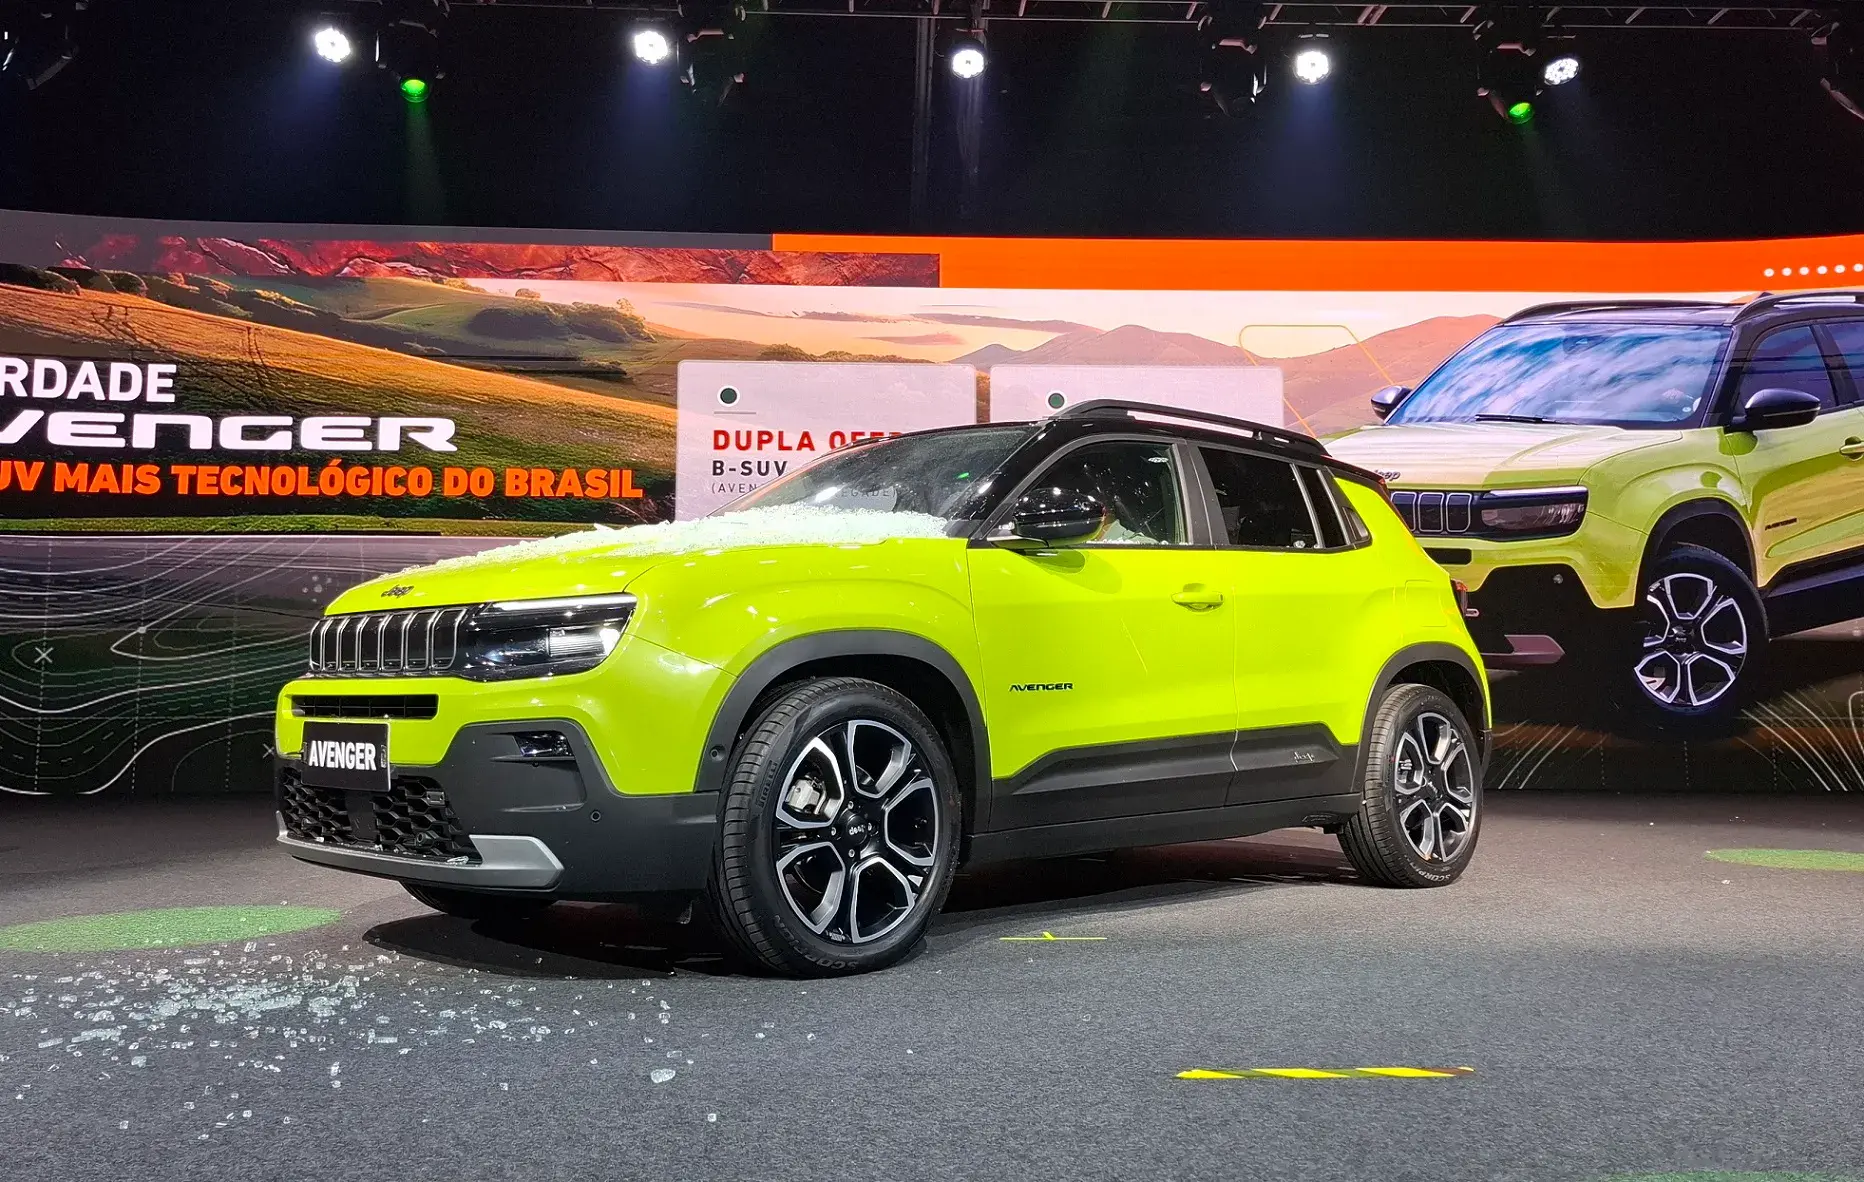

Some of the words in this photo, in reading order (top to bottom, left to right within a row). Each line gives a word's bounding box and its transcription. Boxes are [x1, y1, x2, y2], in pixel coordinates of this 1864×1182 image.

[0, 357, 177, 402] RDADE
[713, 430, 815, 451] DUPLA
[54, 462, 160, 494] MAIS
[171, 458, 433, 497] TECNOLÓGICO
[443, 467, 494, 497] DO
[505, 468, 643, 498] BRASIL
[712, 460, 788, 477] B-SUV
[1009, 683, 1073, 692] AVENGER
[308, 740, 376, 770] AVENGER
